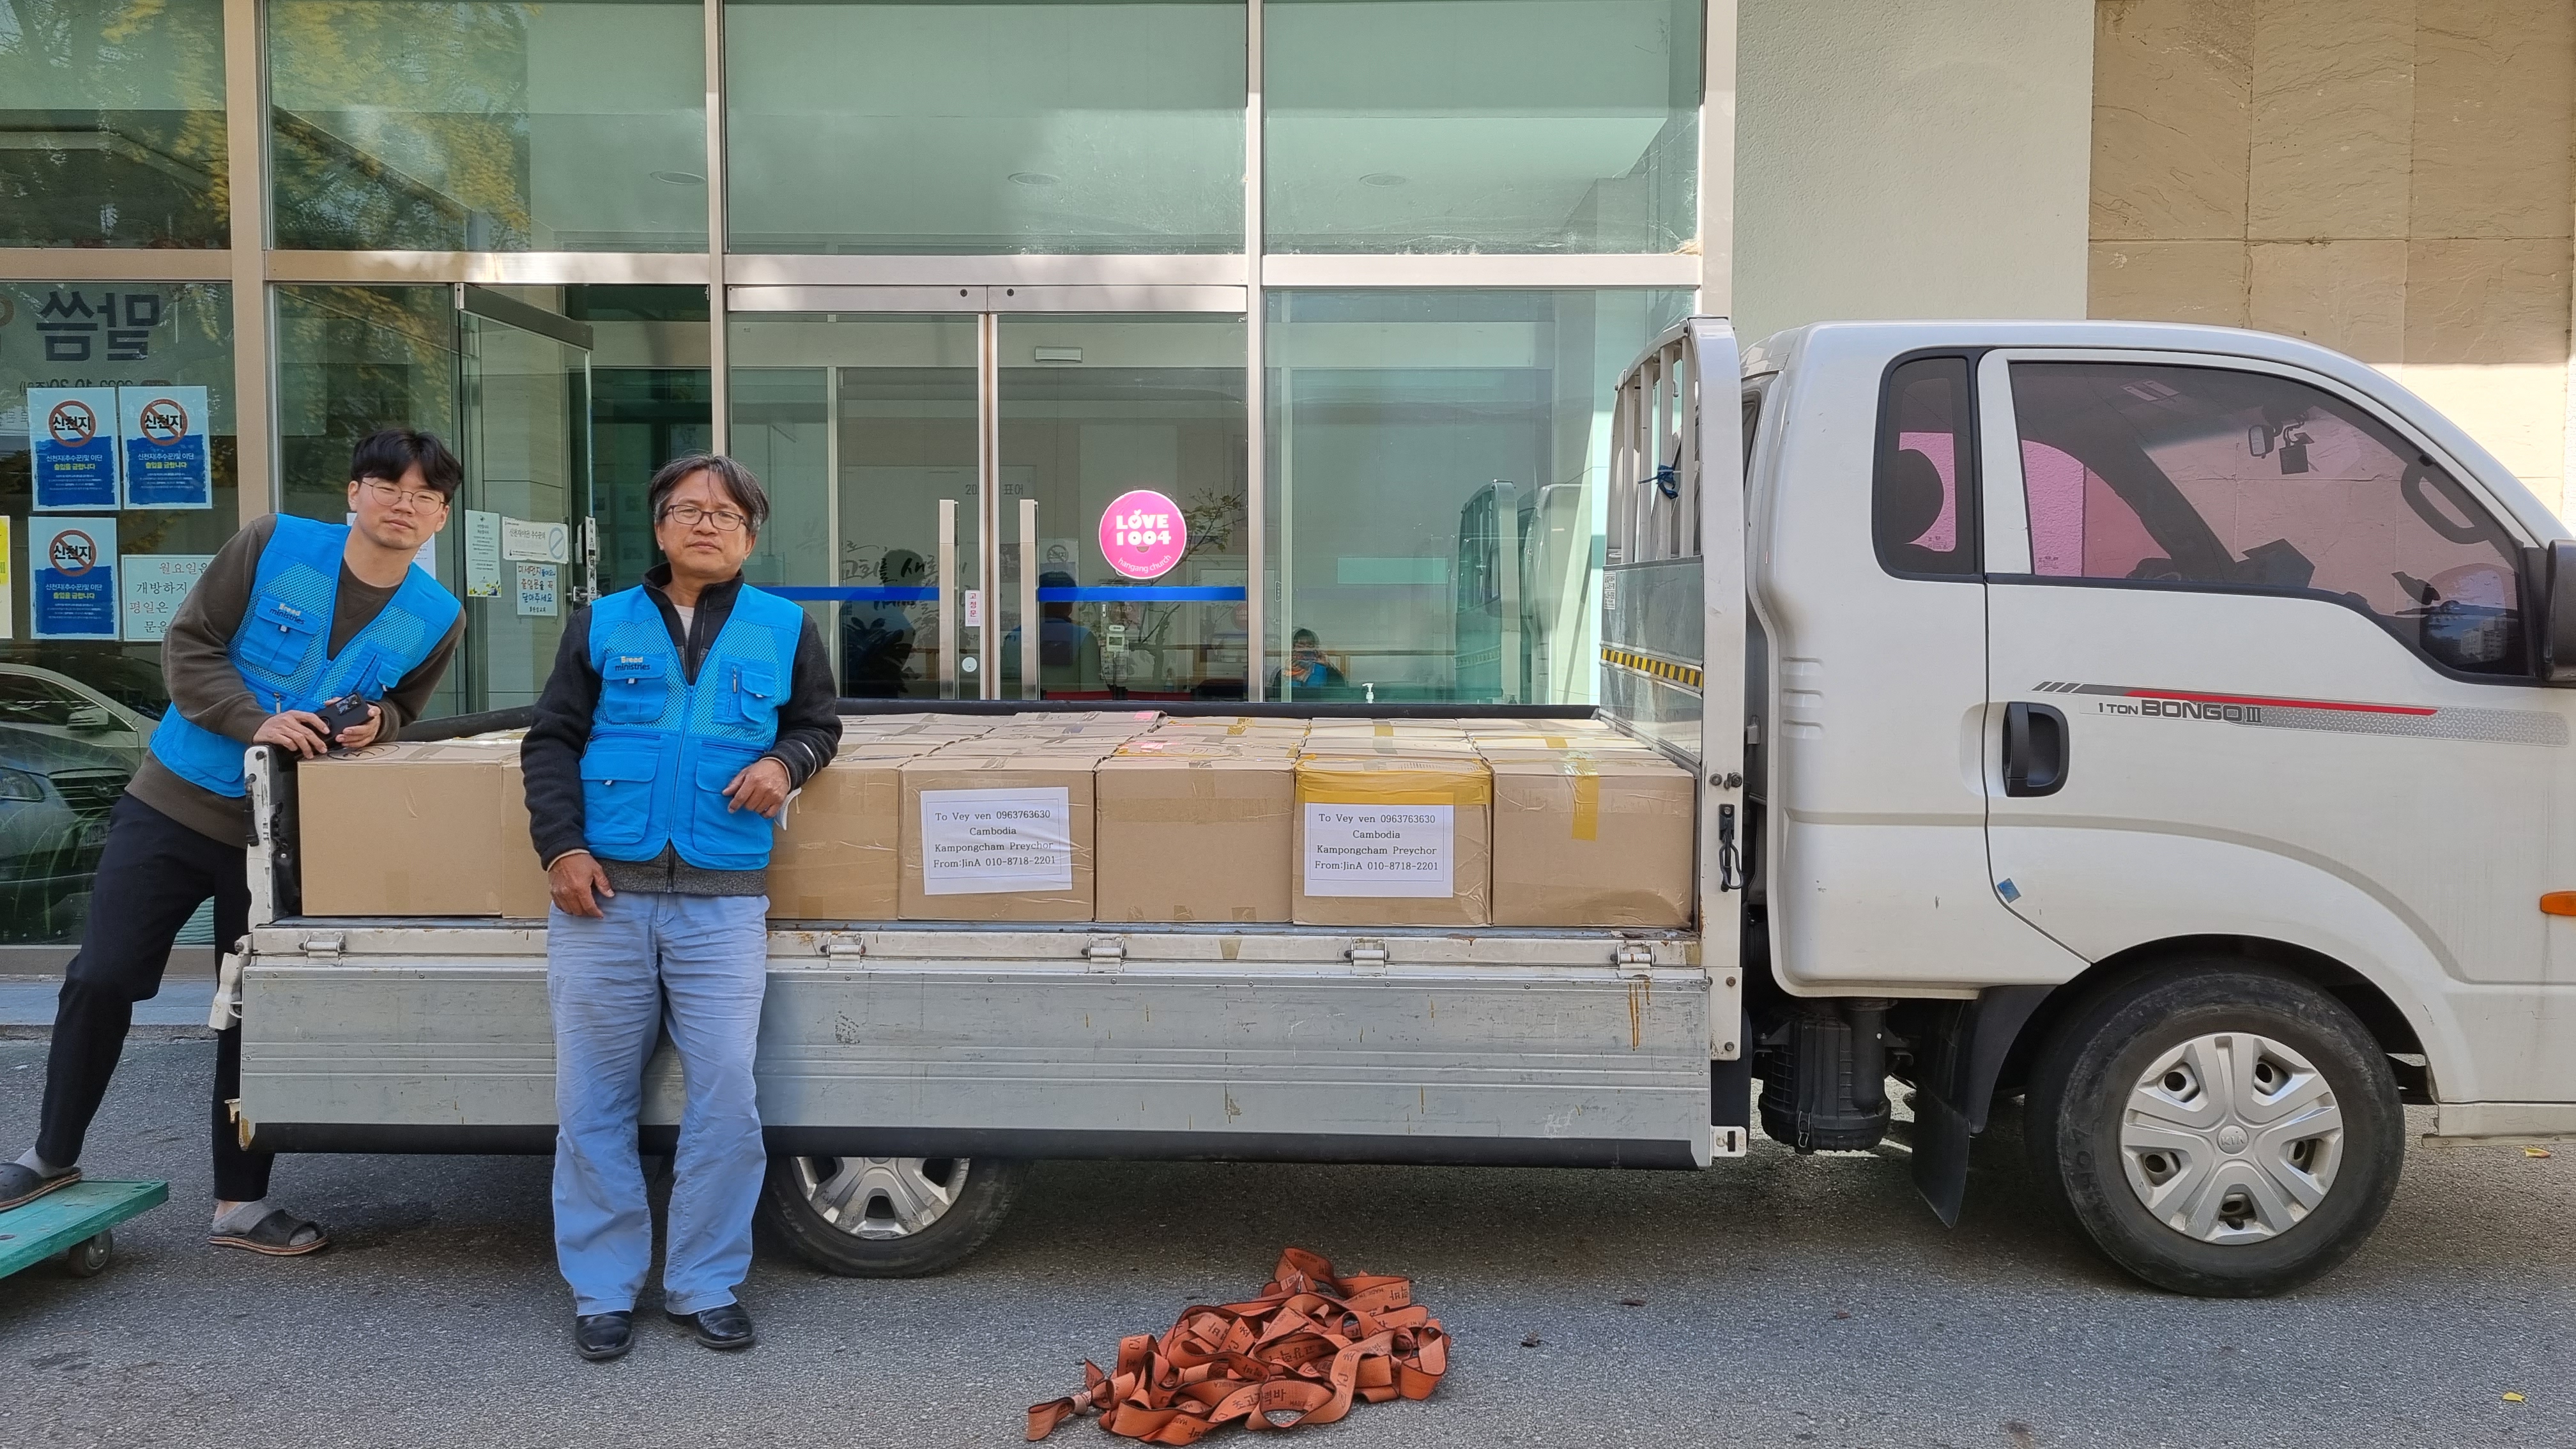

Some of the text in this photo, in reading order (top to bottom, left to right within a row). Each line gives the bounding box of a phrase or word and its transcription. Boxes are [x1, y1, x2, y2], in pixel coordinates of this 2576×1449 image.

[52, 416, 91, 431] 신천지
[144, 414, 183, 430] 신천지
[1116, 511, 1169, 530] LOVE
[1116, 530, 1172, 546] 1004
[53, 545, 91, 560] 신천지
[159, 562, 208, 574] 월요일은
[1118, 555, 1172, 574] hangang church
[137, 581, 187, 595] 개방하지
[130, 601, 169, 614] 평일은
[269, 608, 305, 625] ministries
[144, 620, 167, 633] 문을
[615, 662, 650, 671] ministries
[2106, 704, 2138, 715] TON
[2141, 700, 2243, 721] BONGO
[935, 812, 947, 822] To
[952, 811, 970, 822] Vey
[996, 809, 1051, 820] 0963763630
[1319, 813, 1331, 822] To
[1335, 813, 1354, 824] Vey
[1380, 814, 1436, 824] 0963763630
[969, 826, 1017, 836] Cambodia
[1353, 830, 1400, 839] Cambodia
[935, 841, 1054, 854] Kampongcham Preychor
[1317, 845, 1438, 855] Kampongcham Preychor
[933, 855, 1055, 869] From:JinA 010-8718-2201
[1315, 861, 1438, 871] From:JinA 010-8718-2201
[2221, 1136, 2244, 1146] KIA
